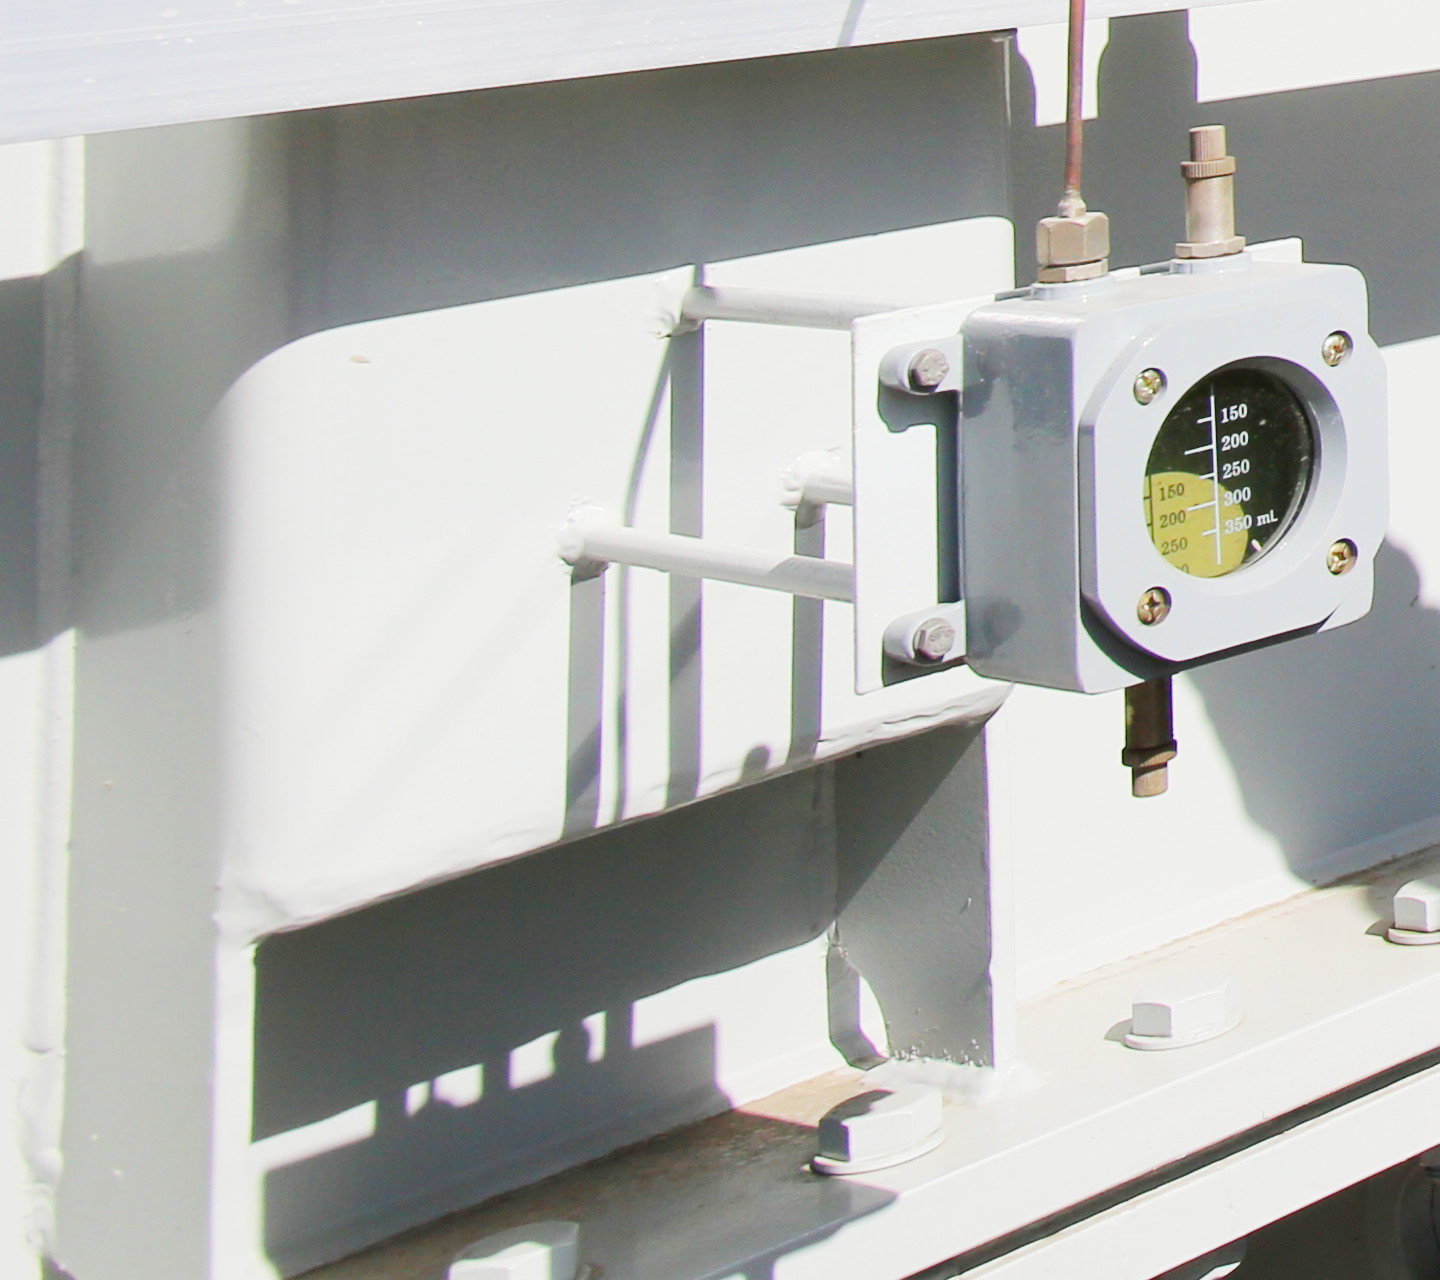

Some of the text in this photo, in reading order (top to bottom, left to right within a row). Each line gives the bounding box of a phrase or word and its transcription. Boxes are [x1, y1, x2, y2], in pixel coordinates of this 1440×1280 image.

[1220, 403, 1248, 424] 150
[1221, 431, 1249, 452] 200
[1222, 458, 1250, 480] 250
[1223, 486, 1251, 507] 300
[1225, 509, 1279, 535] 350 mL
